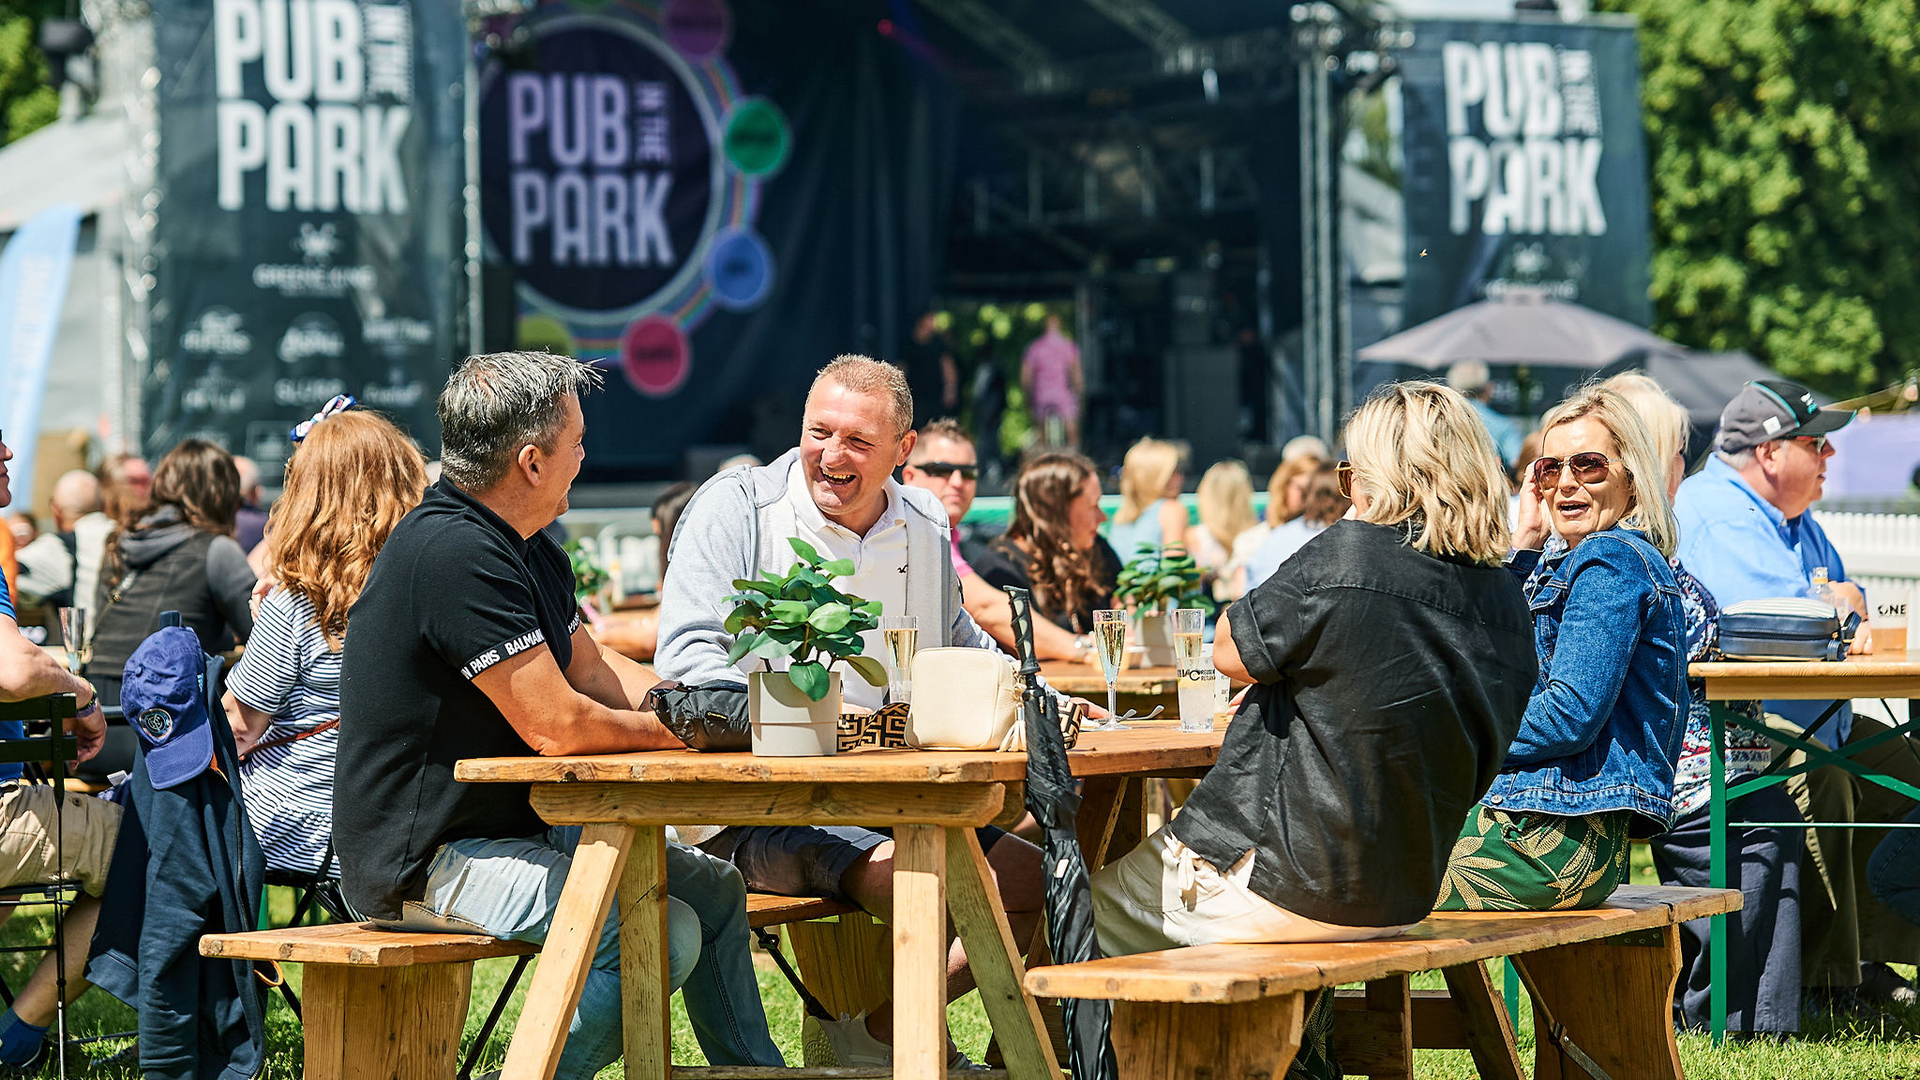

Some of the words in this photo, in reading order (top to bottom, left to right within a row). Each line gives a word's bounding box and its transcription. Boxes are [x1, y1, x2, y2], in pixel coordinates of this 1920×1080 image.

[214, 0, 364, 100] PUB
[1442, 42, 1562, 137] PUB
[217, 103, 412, 213] PARK
[508, 74, 629, 166] PUB
[510, 170, 676, 267] PARK
[1449, 137, 1607, 235] PARK
[470, 649, 501, 674] PARIS
